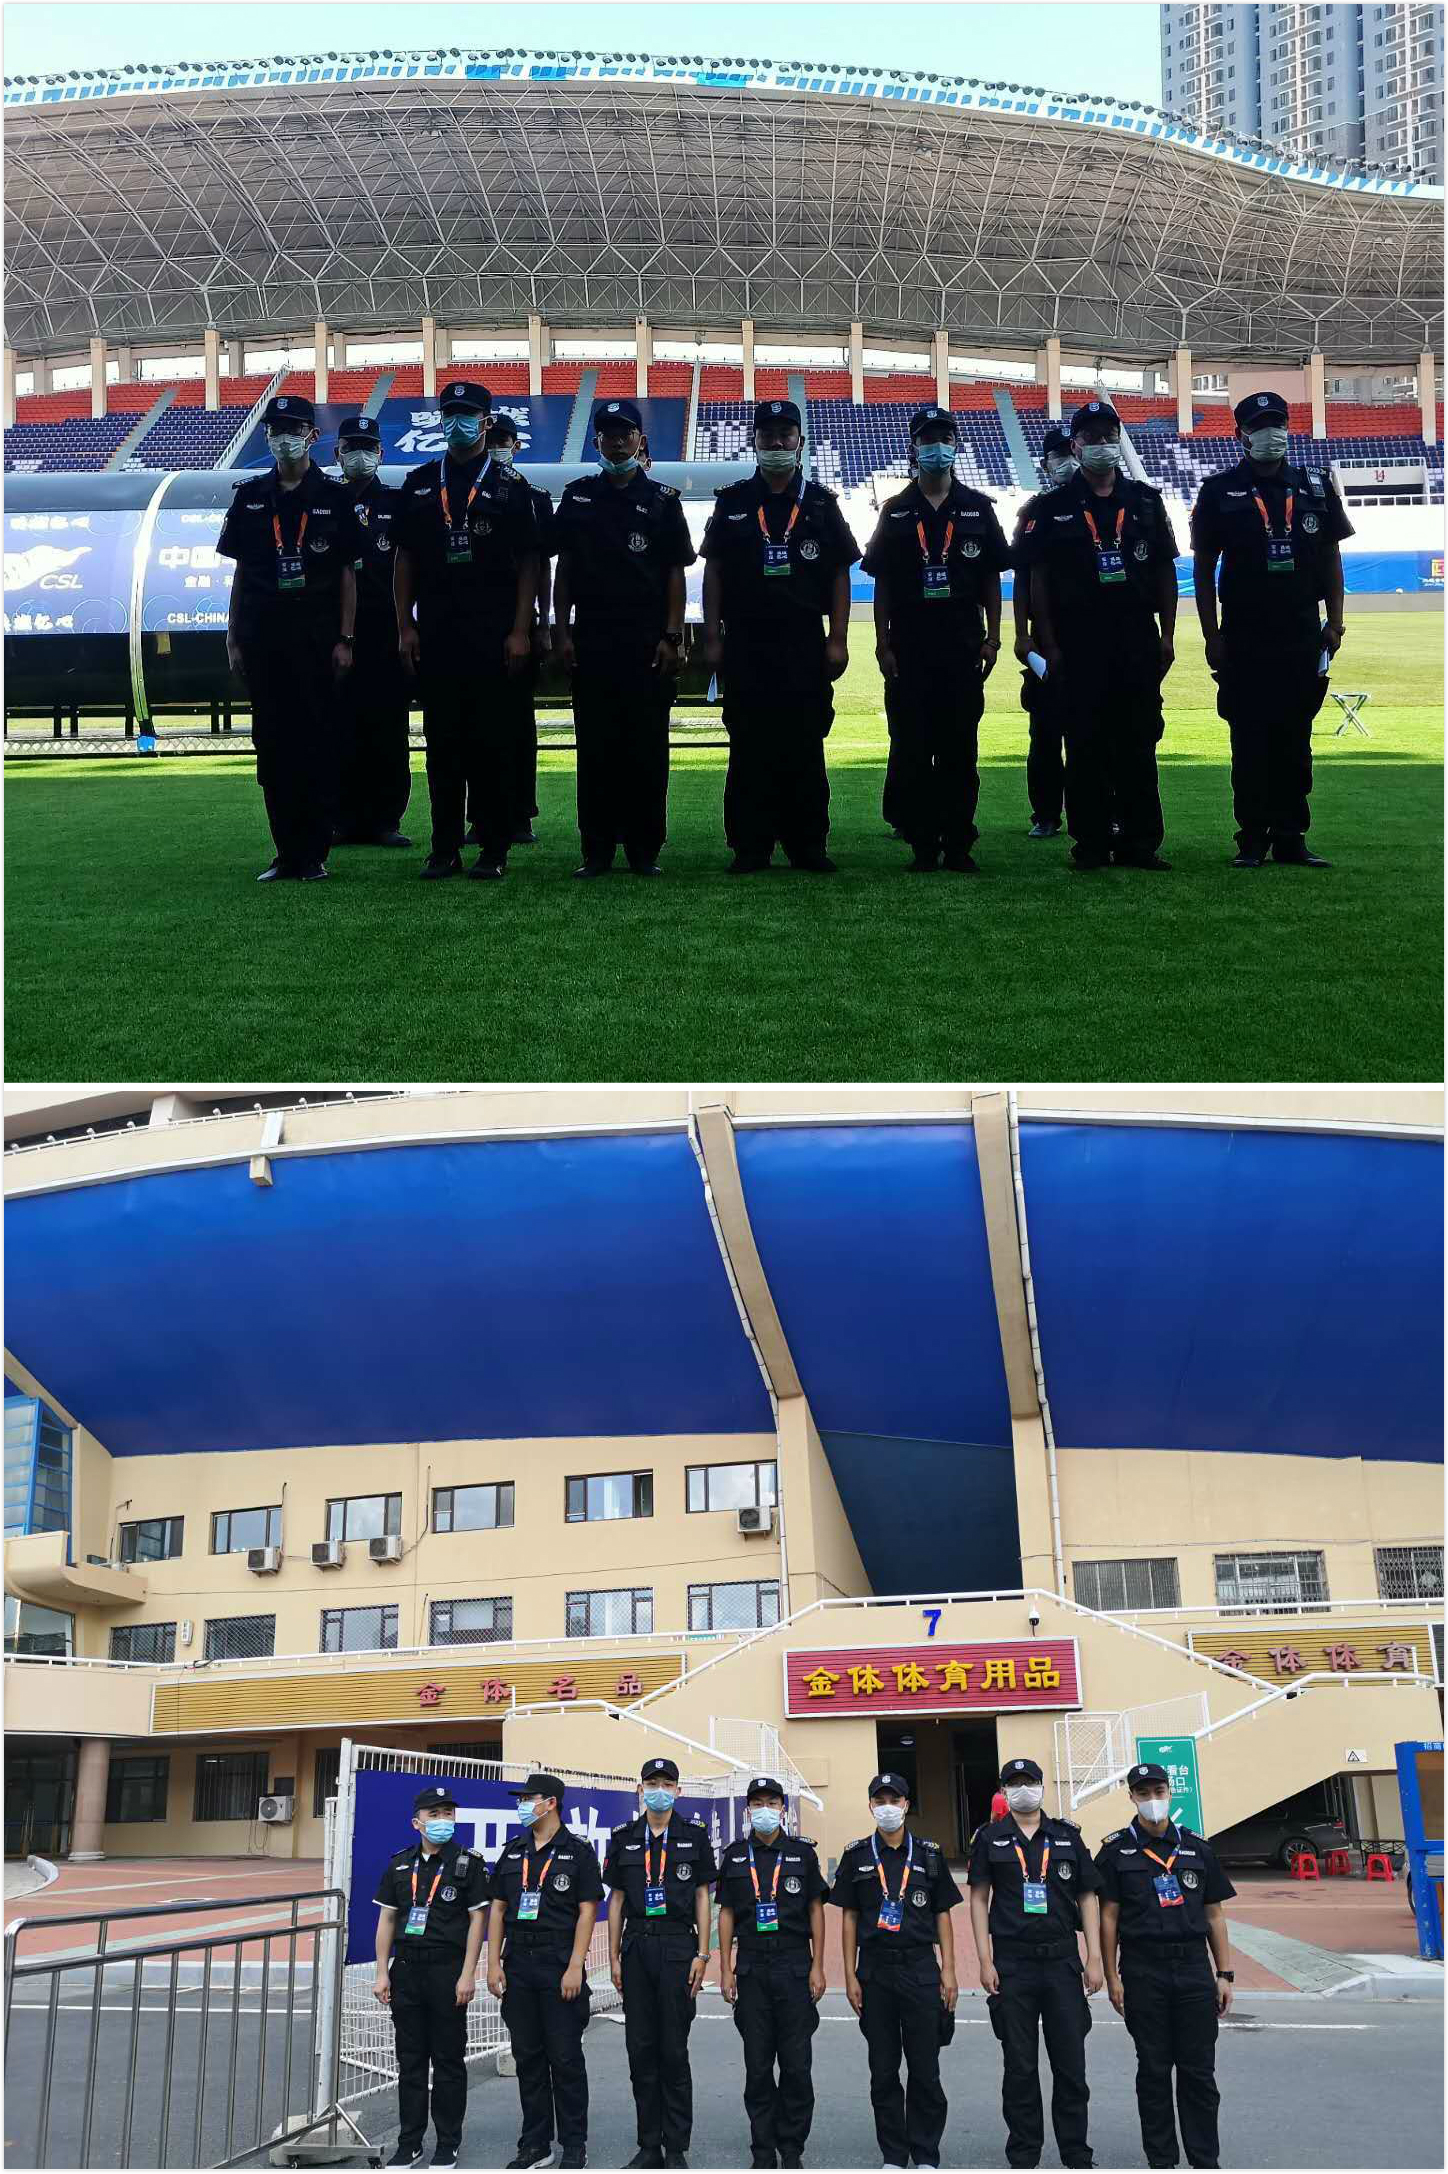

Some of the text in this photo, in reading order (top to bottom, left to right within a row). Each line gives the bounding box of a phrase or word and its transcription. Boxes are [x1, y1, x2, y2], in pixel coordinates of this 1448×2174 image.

[39, 574, 84, 590] CSL
[922, 1608, 942, 1636] 7
[415, 1671, 644, 1708] 金体名品
[802, 1656, 1060, 1698] 金体体育用品
